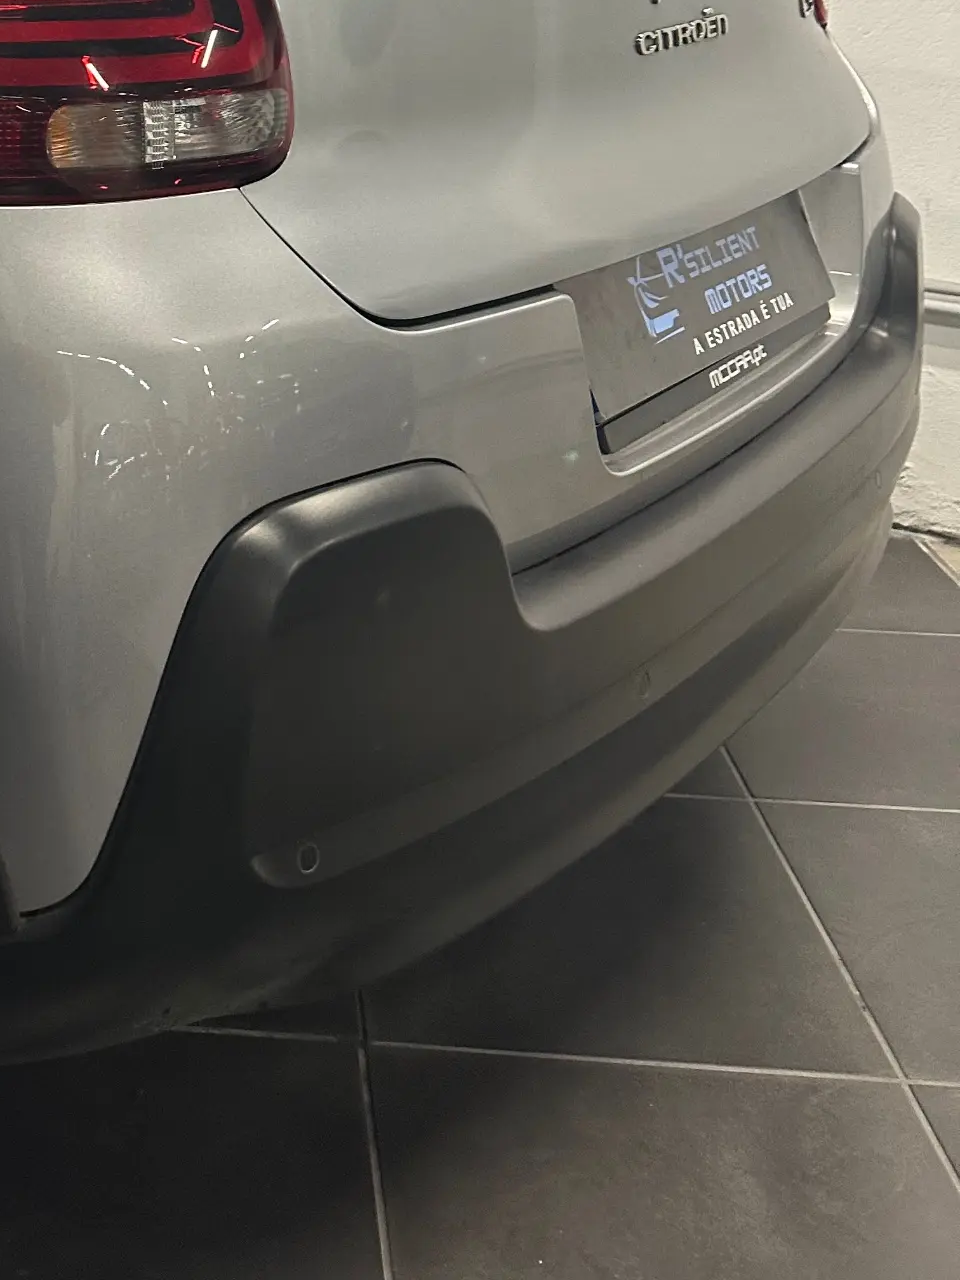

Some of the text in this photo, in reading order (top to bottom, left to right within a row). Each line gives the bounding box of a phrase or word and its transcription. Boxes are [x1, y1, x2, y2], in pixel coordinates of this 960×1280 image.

[704, 263, 773, 315] MOTORS
[692, 292, 794, 356] A ESTRADA É TUA
